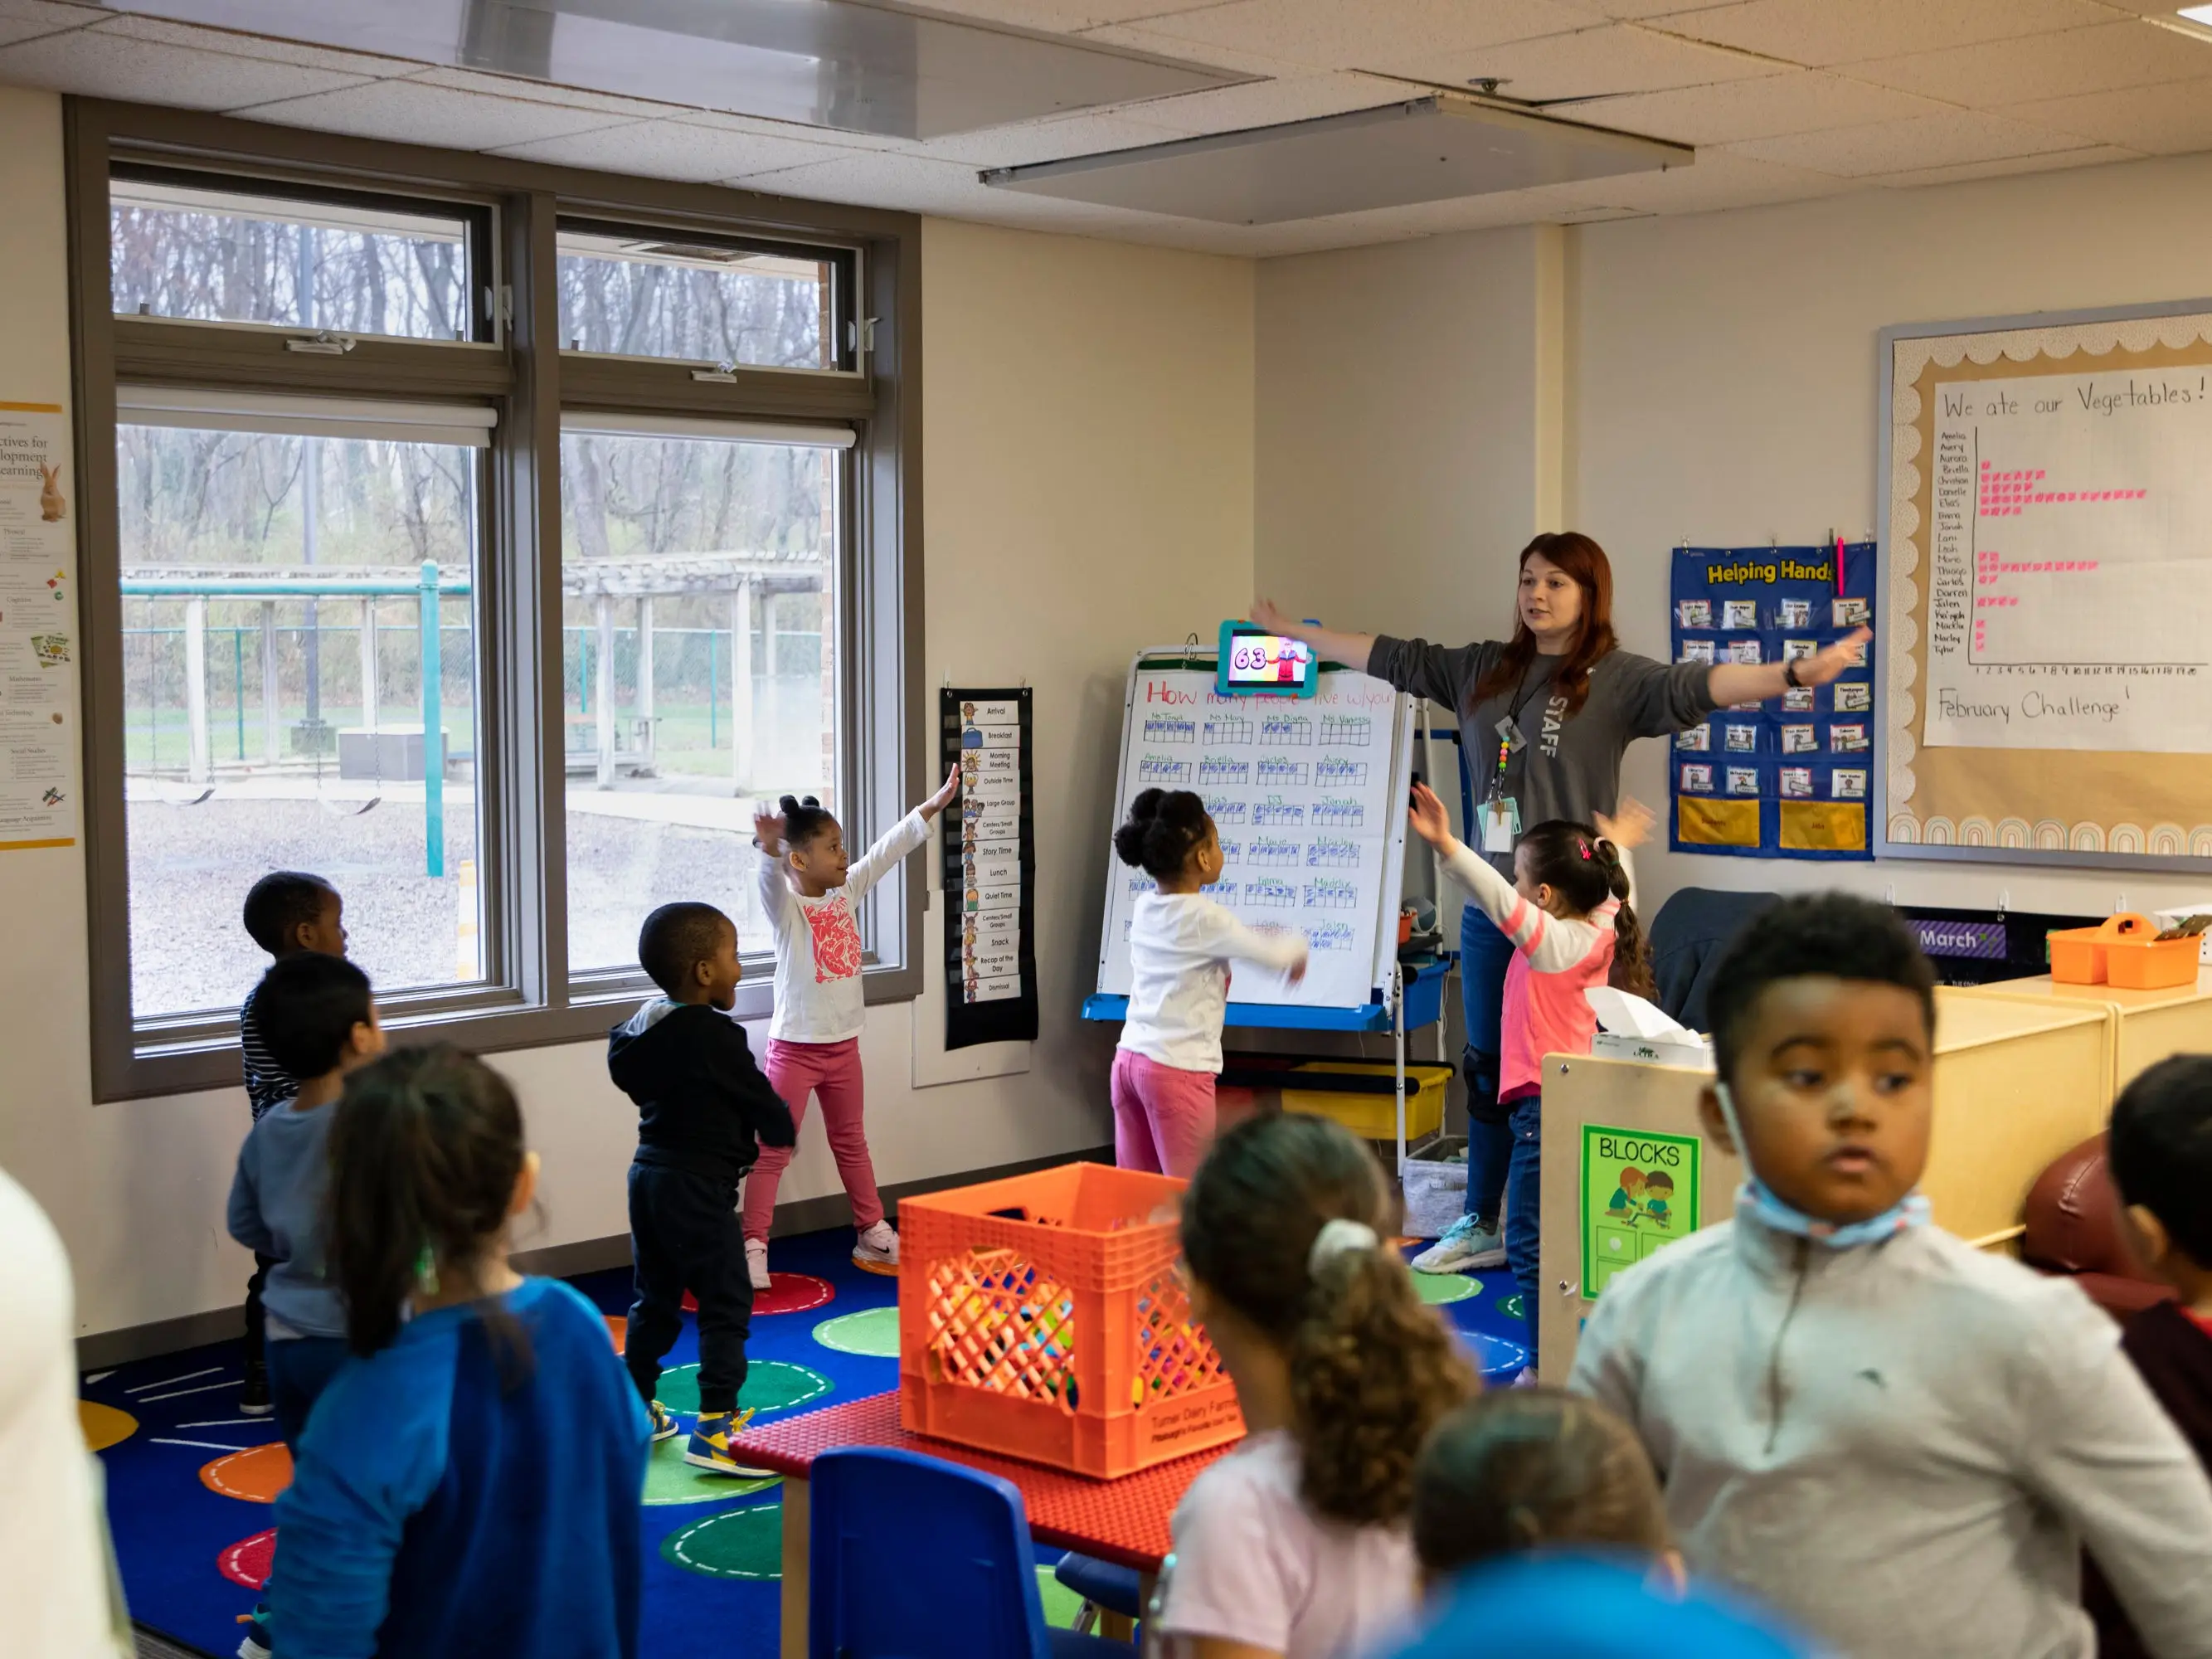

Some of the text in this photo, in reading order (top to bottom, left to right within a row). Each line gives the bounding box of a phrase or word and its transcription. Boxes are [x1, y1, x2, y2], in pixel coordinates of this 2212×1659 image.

[1944, 376, 2205, 417] We ate our Vegetables!
[1942, 431, 1966, 440] Amelia
[32, 435, 48, 449] for
[1939, 454, 1967, 463] Aurora
[1939, 498, 1960, 508] Elias
[1937, 533, 1957, 542] Lani
[1706, 560, 1776, 585] Helping
[1937, 566, 1966, 578] Thiago
[1937, 577, 1964, 586] Carlos
[1937, 589, 1968, 597] Darren
[1234, 647, 1267, 670] 63
[1146, 680, 1198, 705] How
[1314, 692, 1339, 706] live
[1938, 688, 2010, 724] February
[986, 707, 1006, 715] Arrival
[1339, 714, 1371, 724] Vanessa
[1539, 695, 1568, 759] STAFF
[989, 752, 1011, 761] Morning
[1145, 752, 1174, 761] Amelia
[1204, 755, 1234, 763] Briella
[989, 761, 1011, 770] Meeting
[986, 799, 1015, 808] Large Group
[1267, 795, 1283, 805] DJ
[982, 848, 998, 856] Story
[989, 868, 1008, 877] Lunch
[984, 892, 999, 900] Quiet
[991, 938, 1009, 946] Snack
[1919, 930, 1977, 949] March
[980, 956, 999, 965] Recap
[992, 965, 1004, 974] Day
[989, 983, 1010, 991] Dismissal
[1599, 1136, 1680, 1167] BLOCKS
